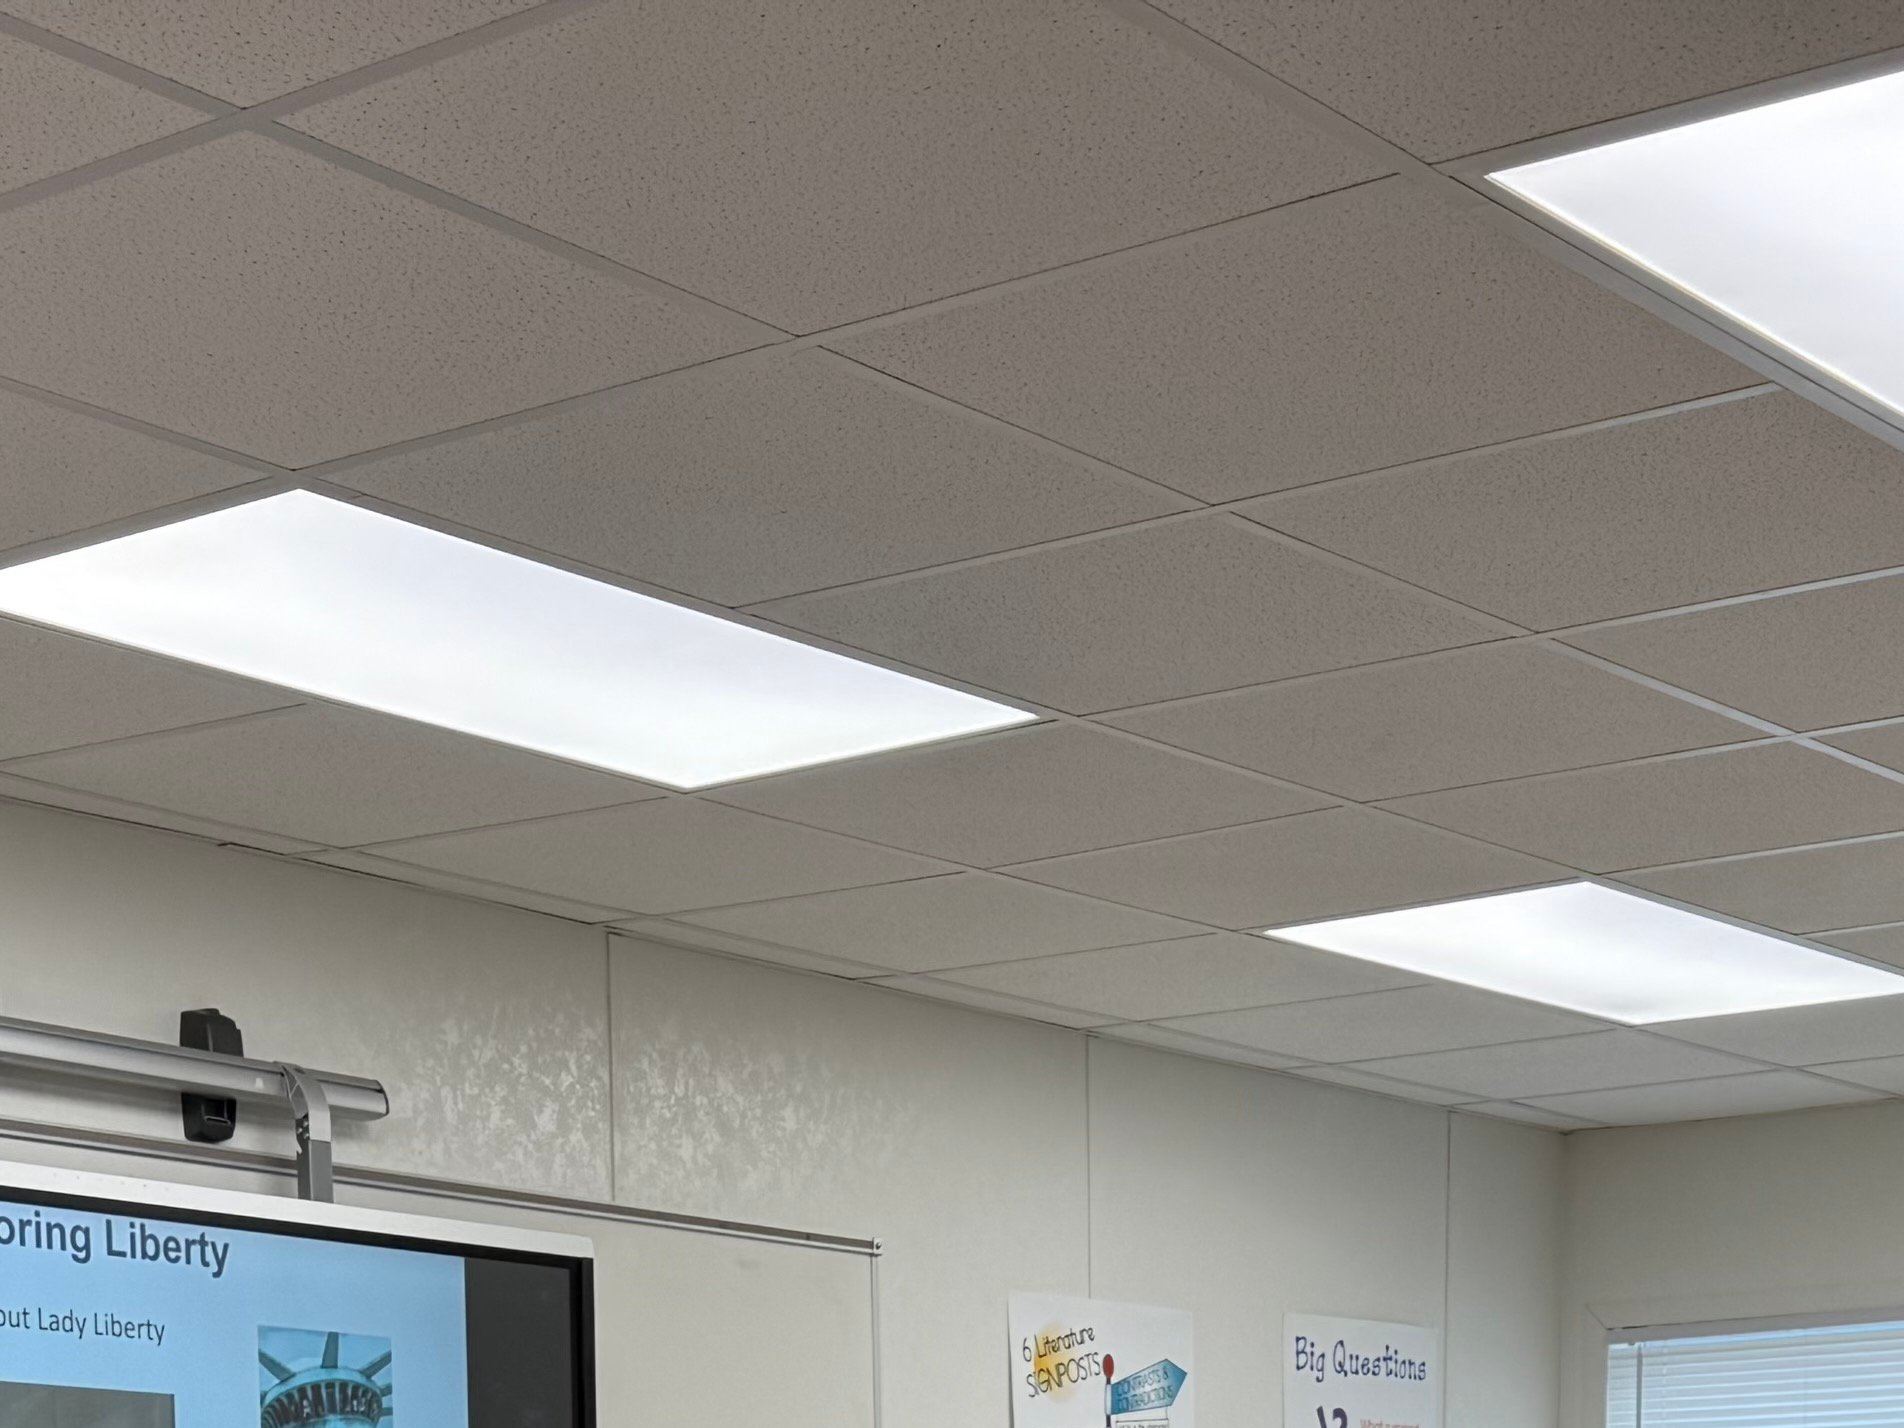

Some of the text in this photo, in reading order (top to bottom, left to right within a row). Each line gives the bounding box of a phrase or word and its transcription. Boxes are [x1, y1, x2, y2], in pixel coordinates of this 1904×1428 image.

[105, 1218, 230, 1279] Liberty
[38, 1307, 87, 1340] Lady
[94, 1313, 165, 1346] Liberty
[1022, 1327, 1095, 1362] 6 Literature
[1026, 1352, 1101, 1398] SIGNPOSTS
[1295, 1336, 1426, 1383] Big Questions
